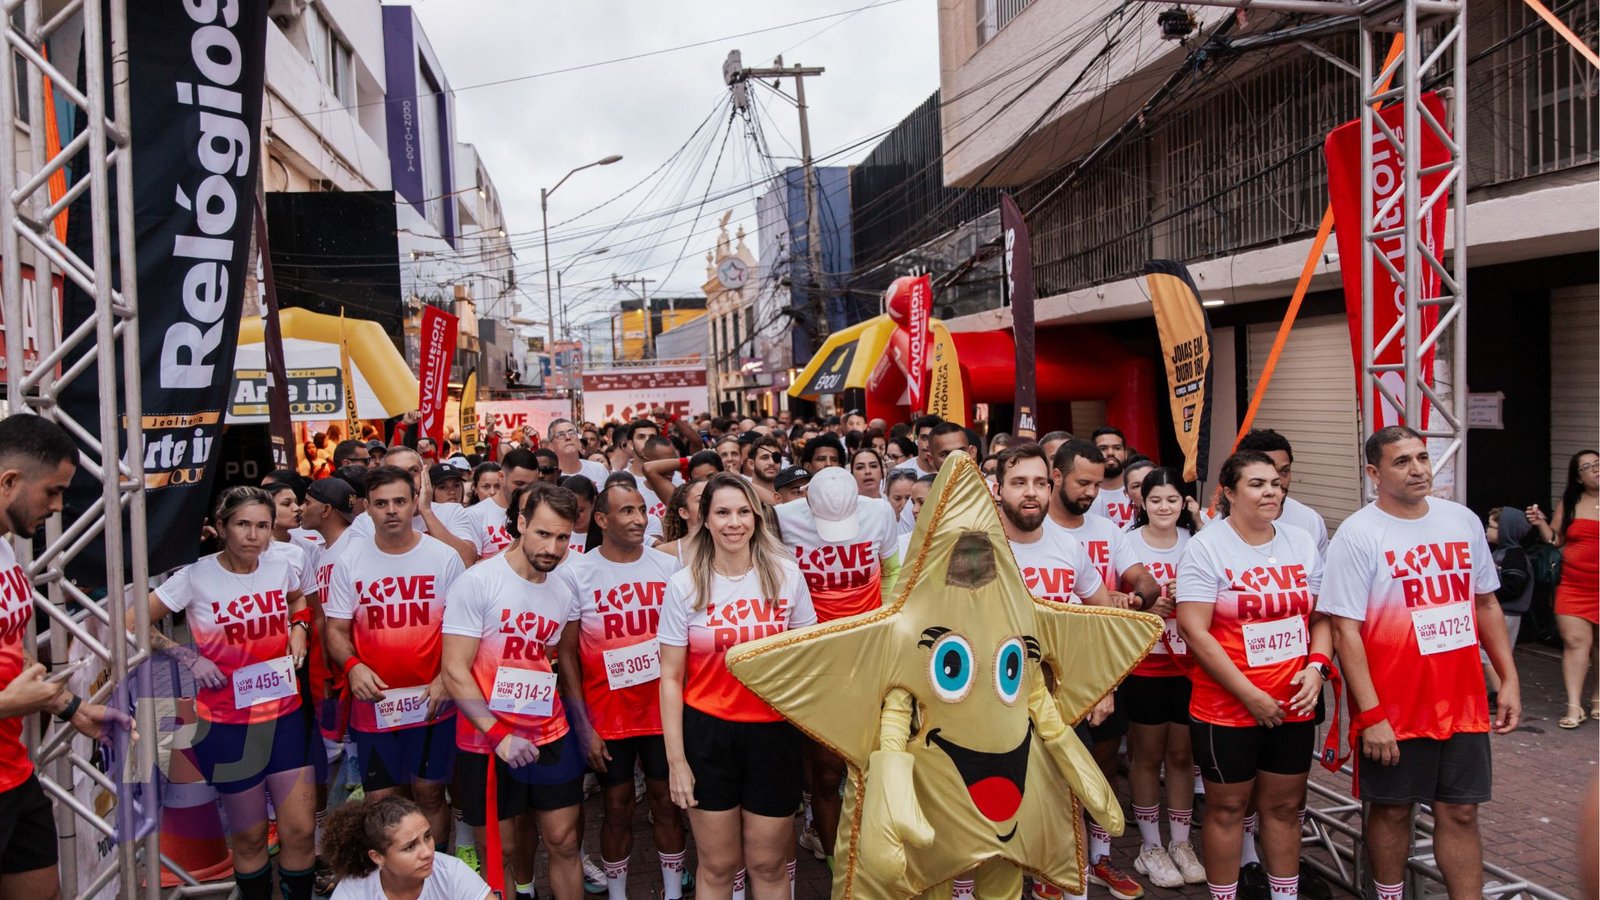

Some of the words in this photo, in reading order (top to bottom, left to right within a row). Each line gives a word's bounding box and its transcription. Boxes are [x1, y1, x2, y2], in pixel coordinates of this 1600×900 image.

[402, 100, 416, 172] ODONTOLOGIA
[422, 316, 443, 414] evolution
[1172, 340, 1193, 364] JOIAS
[1175, 361, 1194, 383] OURO
[234, 380, 299, 402] Are
[307, 379, 337, 401] in
[932, 365, 943, 415] URANÇA
[941, 362, 949, 421] TRÔNICA
[152, 416, 204, 427] Joalheria
[290, 402, 336, 413] OURO
[123, 434, 187, 468] rte
[796, 541, 875, 572] LOVE
[1385, 541, 1473, 579] LOVE
[355, 575, 435, 605] LOVE
[804, 566, 872, 592] RUN
[1225, 564, 1307, 593] LOVE
[1402, 572, 1472, 608] RUN
[211, 589, 288, 625] LOVE
[366, 601, 430, 630] RUN
[706, 598, 789, 627] LOVE
[1238, 589, 1309, 621] RUN
[224, 613, 286, 645] RUN
[1268, 628, 1302, 650] 472-1
[1439, 615, 1471, 636] 472-2
[626, 649, 660, 674] 305-1
[238, 684, 253, 692] RUN
[255, 668, 292, 690] 455-1
[497, 687, 513, 695] RUN
[514, 682, 551, 702] 314-2
[379, 706, 395, 714] RUN
